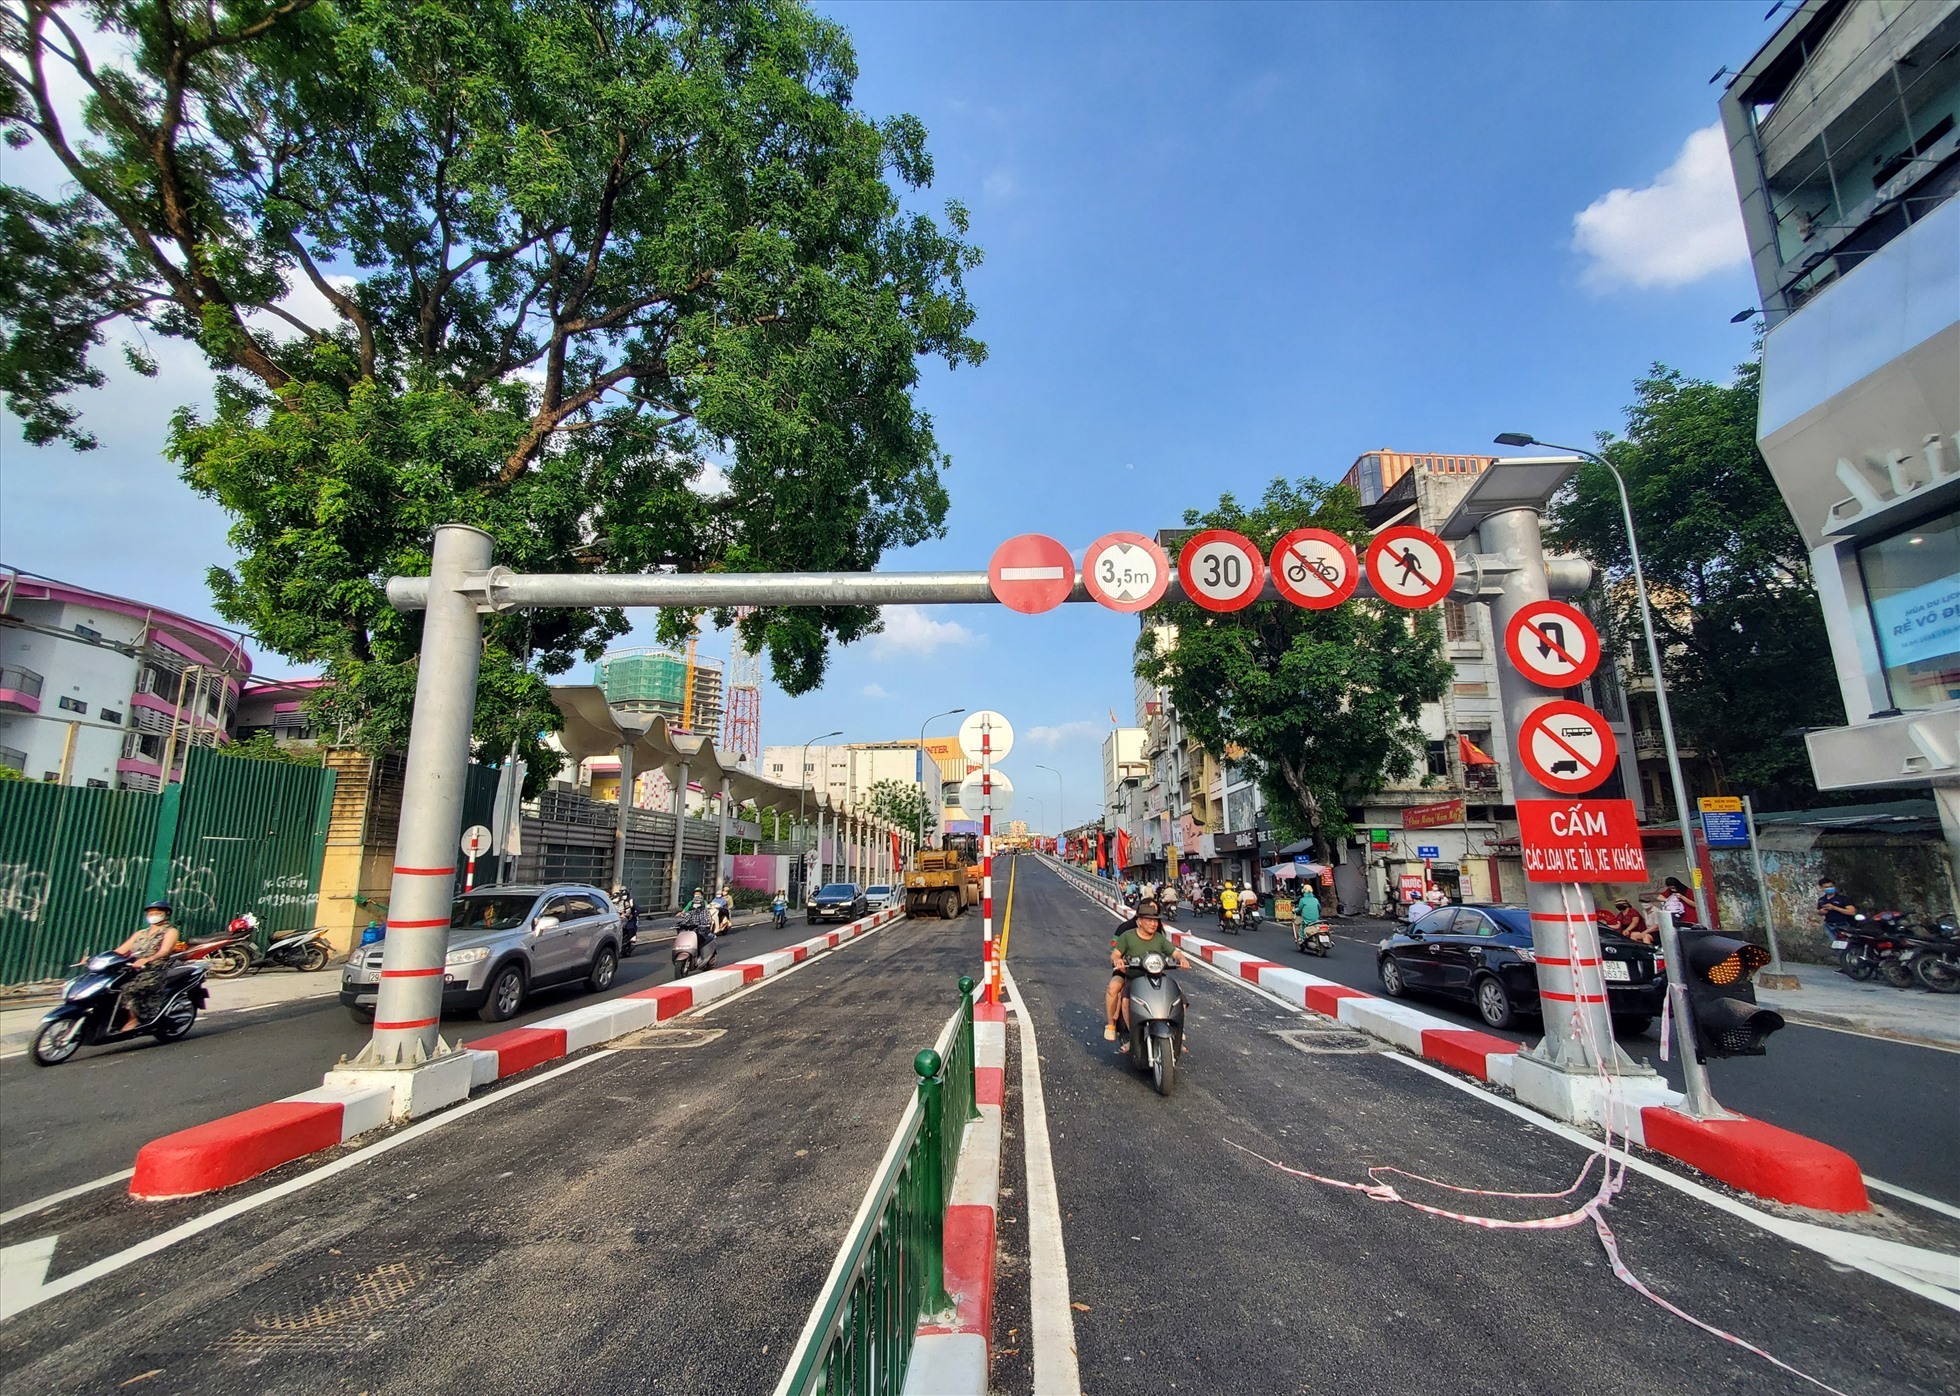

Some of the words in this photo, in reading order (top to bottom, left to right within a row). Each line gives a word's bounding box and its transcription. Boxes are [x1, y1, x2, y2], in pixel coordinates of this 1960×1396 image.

[1821, 430, 1960, 537] Ati
[1101, 559, 1149, 588] 3,5m
[1203, 554, 1241, 587] 30
[1915, 610, 1938, 627] VÔ
[1550, 803, 1608, 837] CẤM
[1525, 843, 1544, 871] CÁC
[1544, 848, 1565, 874] LOẠI
[1564, 848, 1579, 871] XE
[1595, 848, 1611, 871] XE
[1611, 843, 1646, 871] KHÁCH
